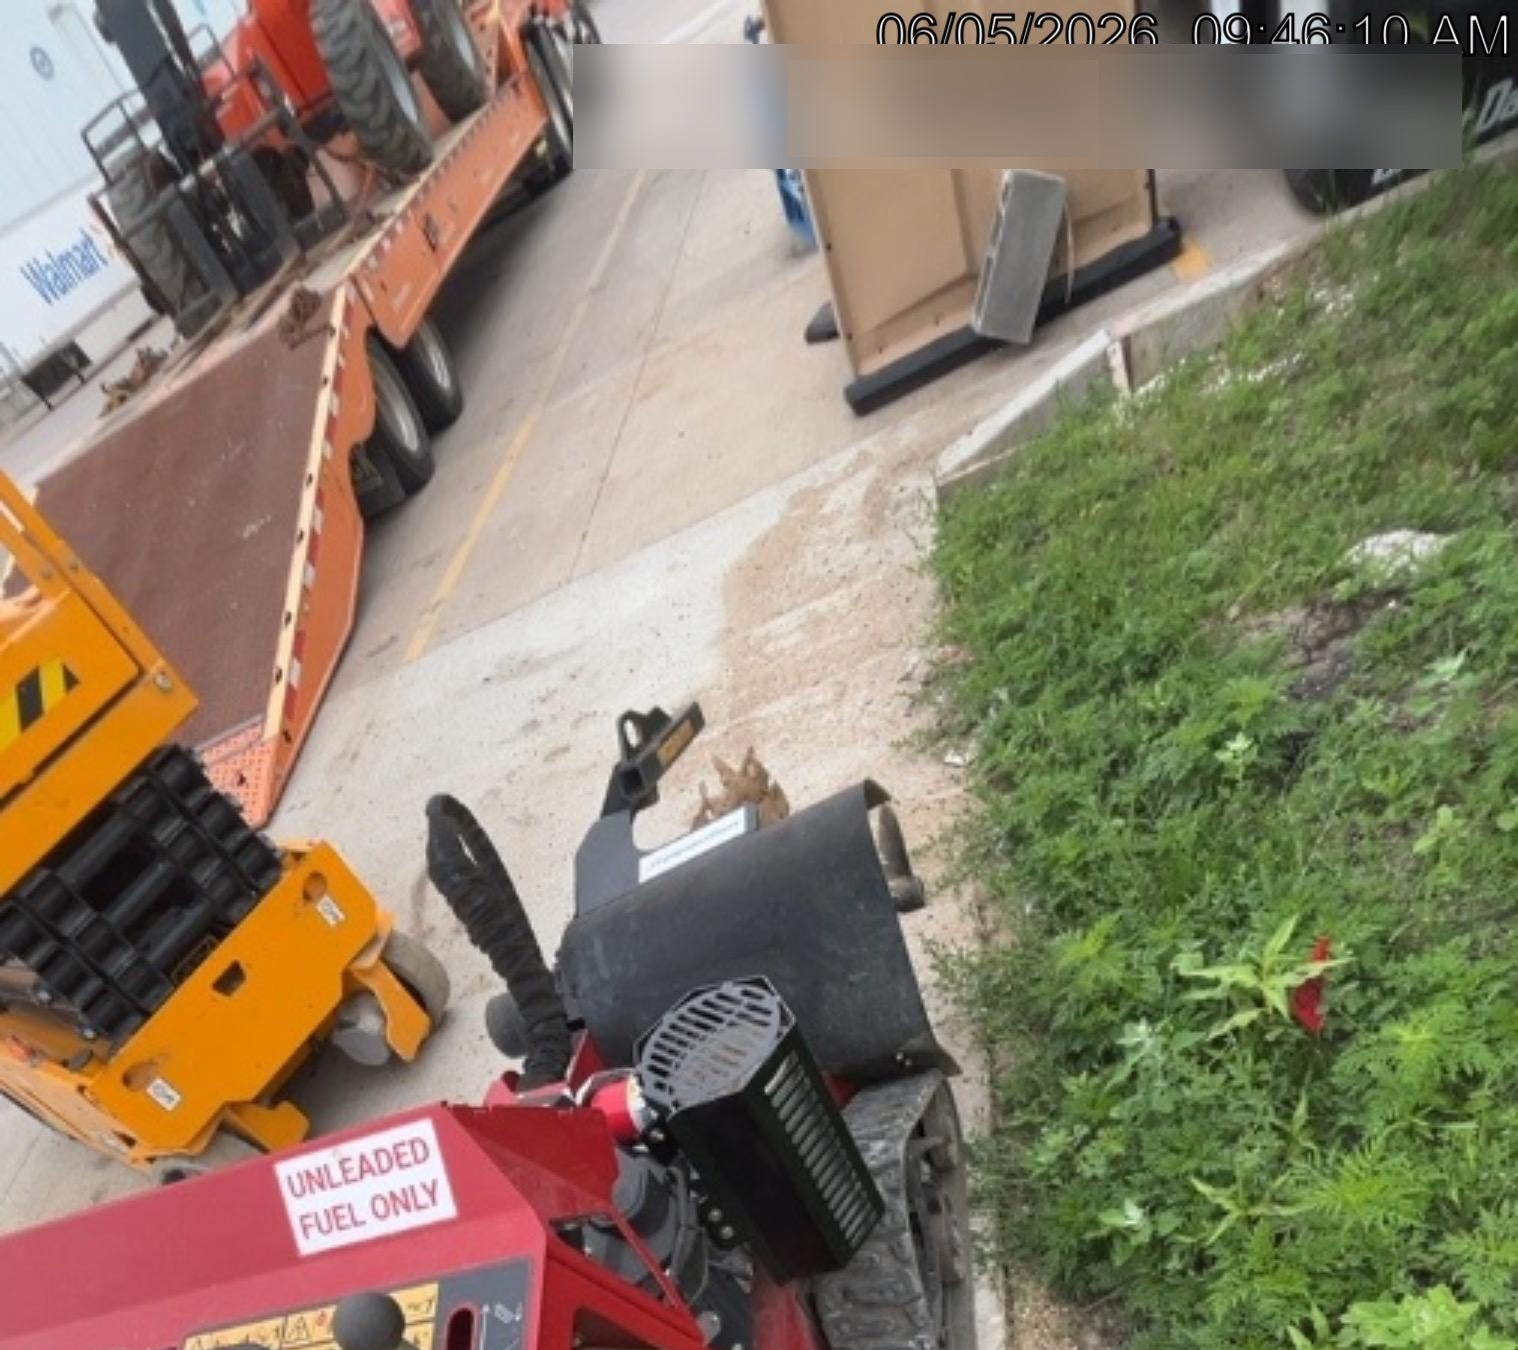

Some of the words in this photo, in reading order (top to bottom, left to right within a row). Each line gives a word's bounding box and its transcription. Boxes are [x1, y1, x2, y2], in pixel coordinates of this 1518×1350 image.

[19, 227, 107, 305] Walmart
[286, 1136, 430, 1199] UNLEADED
[299, 1202, 366, 1240] FUEL
[370, 1179, 438, 1221] ONLY
